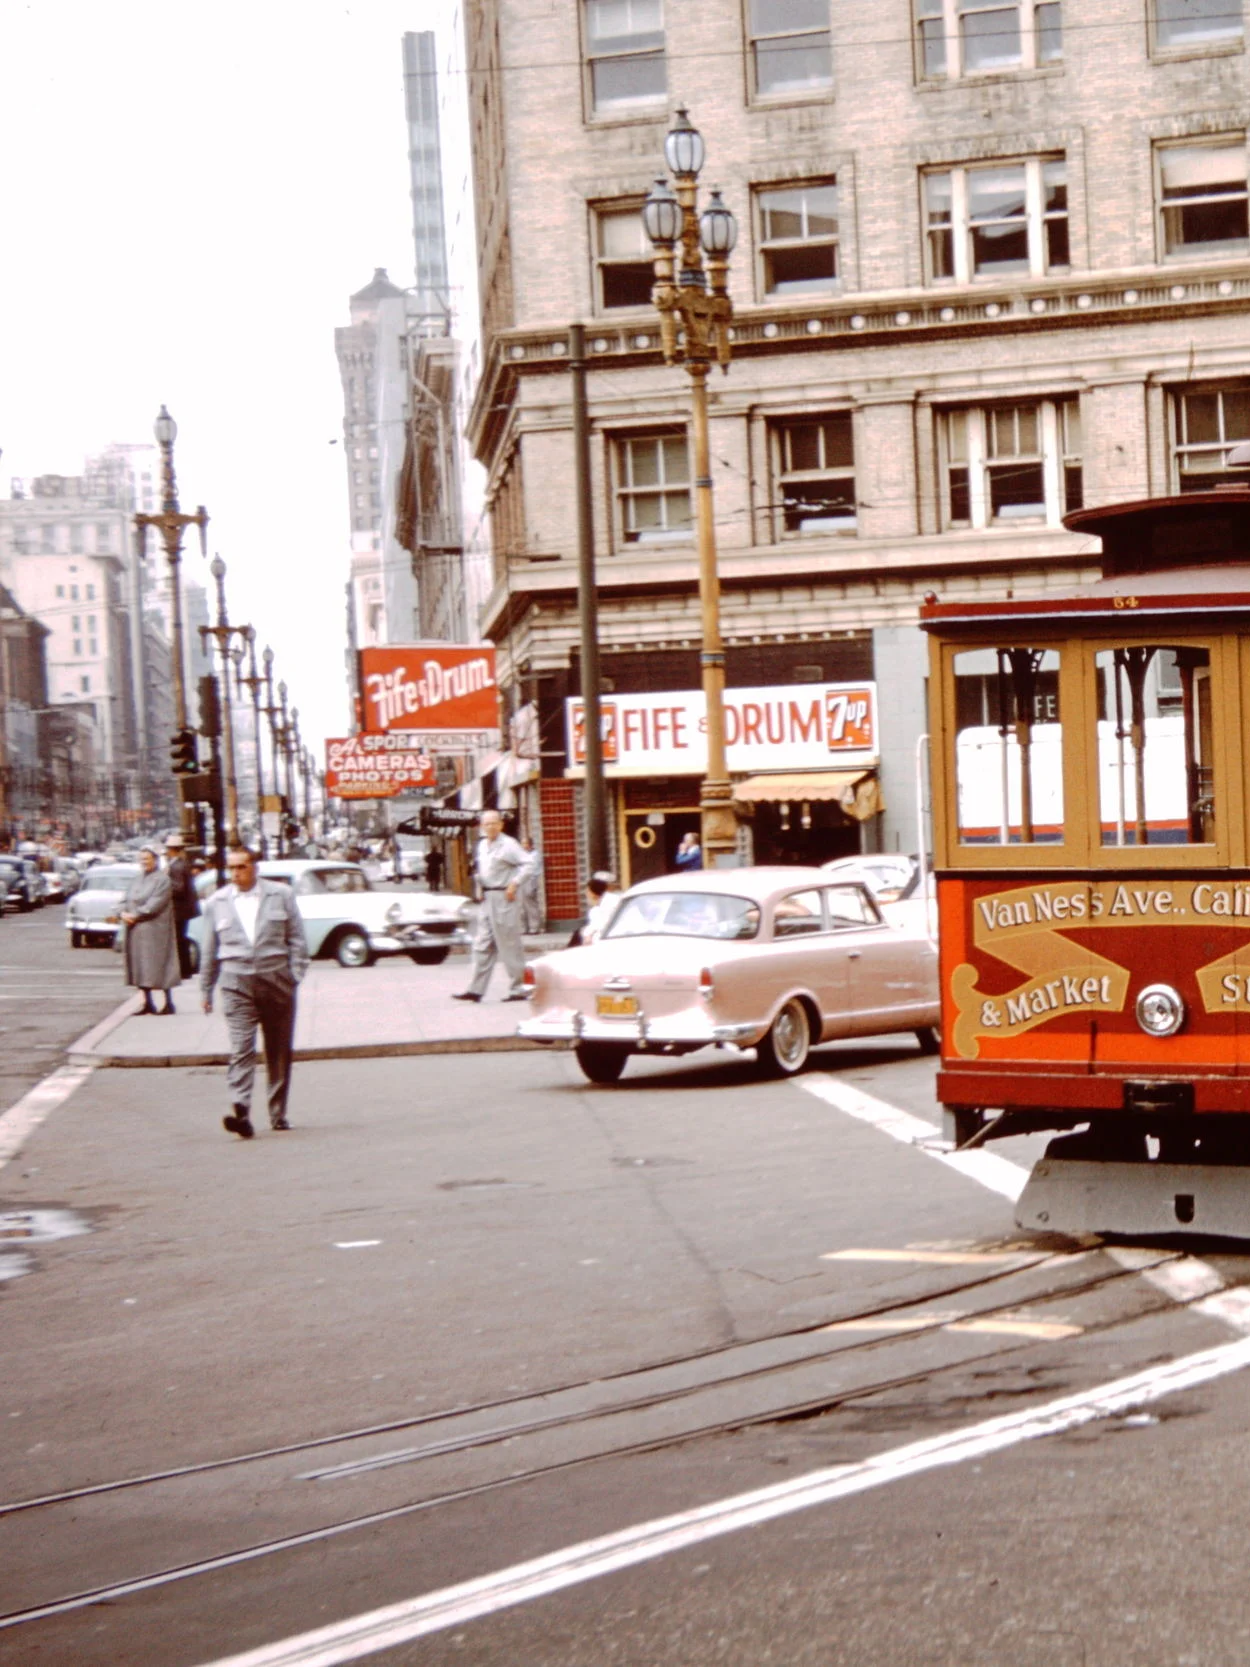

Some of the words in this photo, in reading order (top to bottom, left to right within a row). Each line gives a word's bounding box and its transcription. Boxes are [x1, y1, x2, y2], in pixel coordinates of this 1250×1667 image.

[423, 658, 495, 706] Drum
[622, 707, 688, 751] FIFE
[723, 700, 823, 747] DRUM
[328, 754, 432, 772] CAMERAS
[338, 769, 424, 782] PHOTOS
[979, 897, 1033, 930] Van
[1031, 890, 1104, 922] Ness
[980, 1000, 1001, 1027] &
[1006, 975, 1112, 1026] Market
